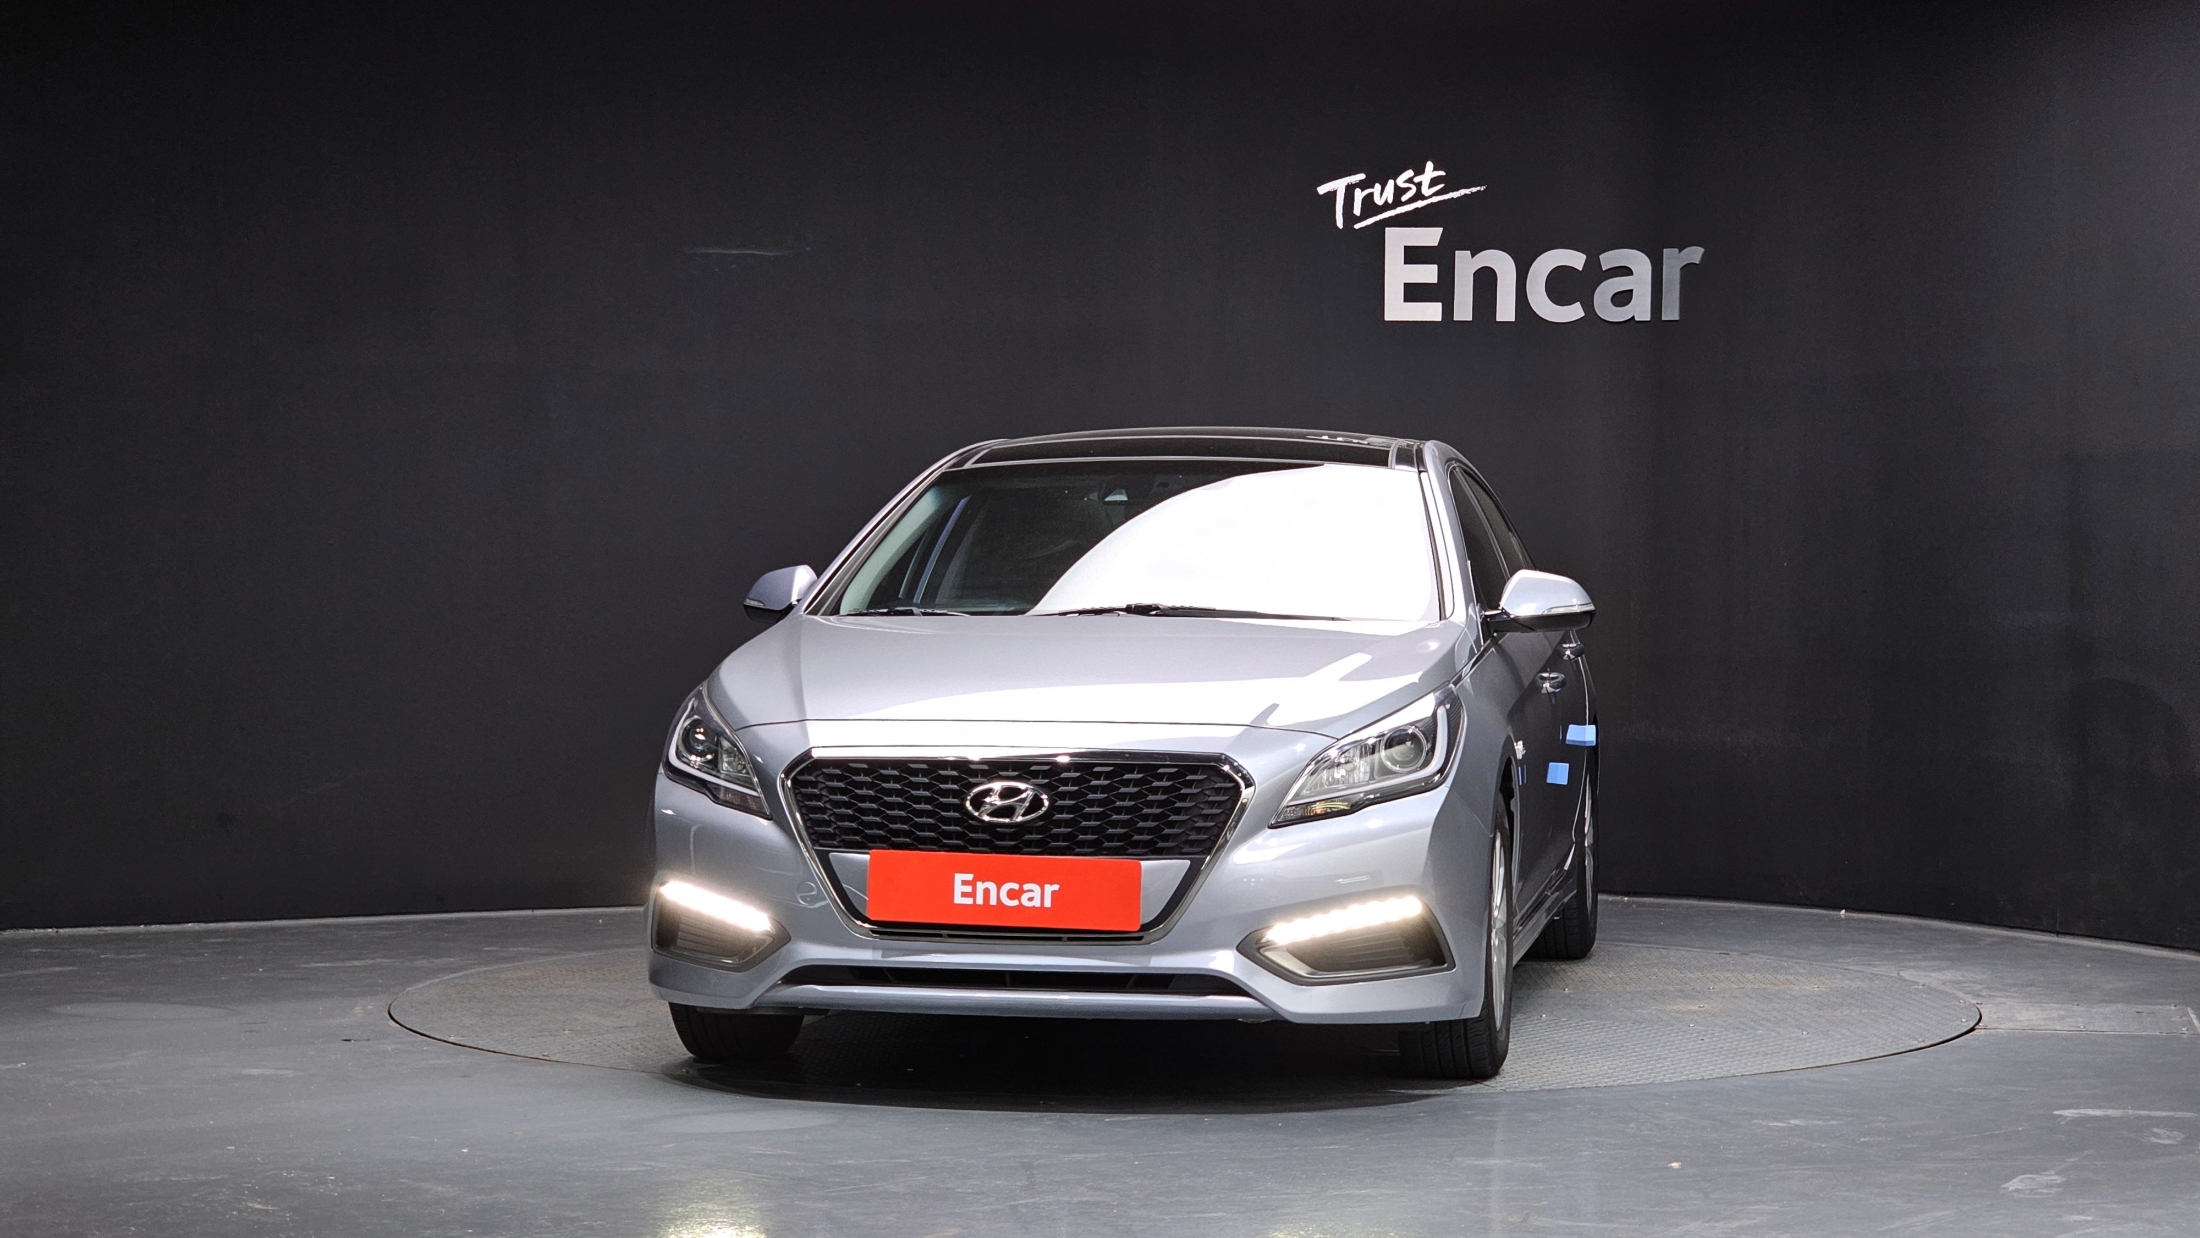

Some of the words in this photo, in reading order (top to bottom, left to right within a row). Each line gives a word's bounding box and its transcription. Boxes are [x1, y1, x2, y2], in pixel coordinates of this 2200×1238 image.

[1317, 160, 1447, 229] Trust
[1384, 227, 1705, 323] Encar
[953, 873, 1059, 908] Encar
